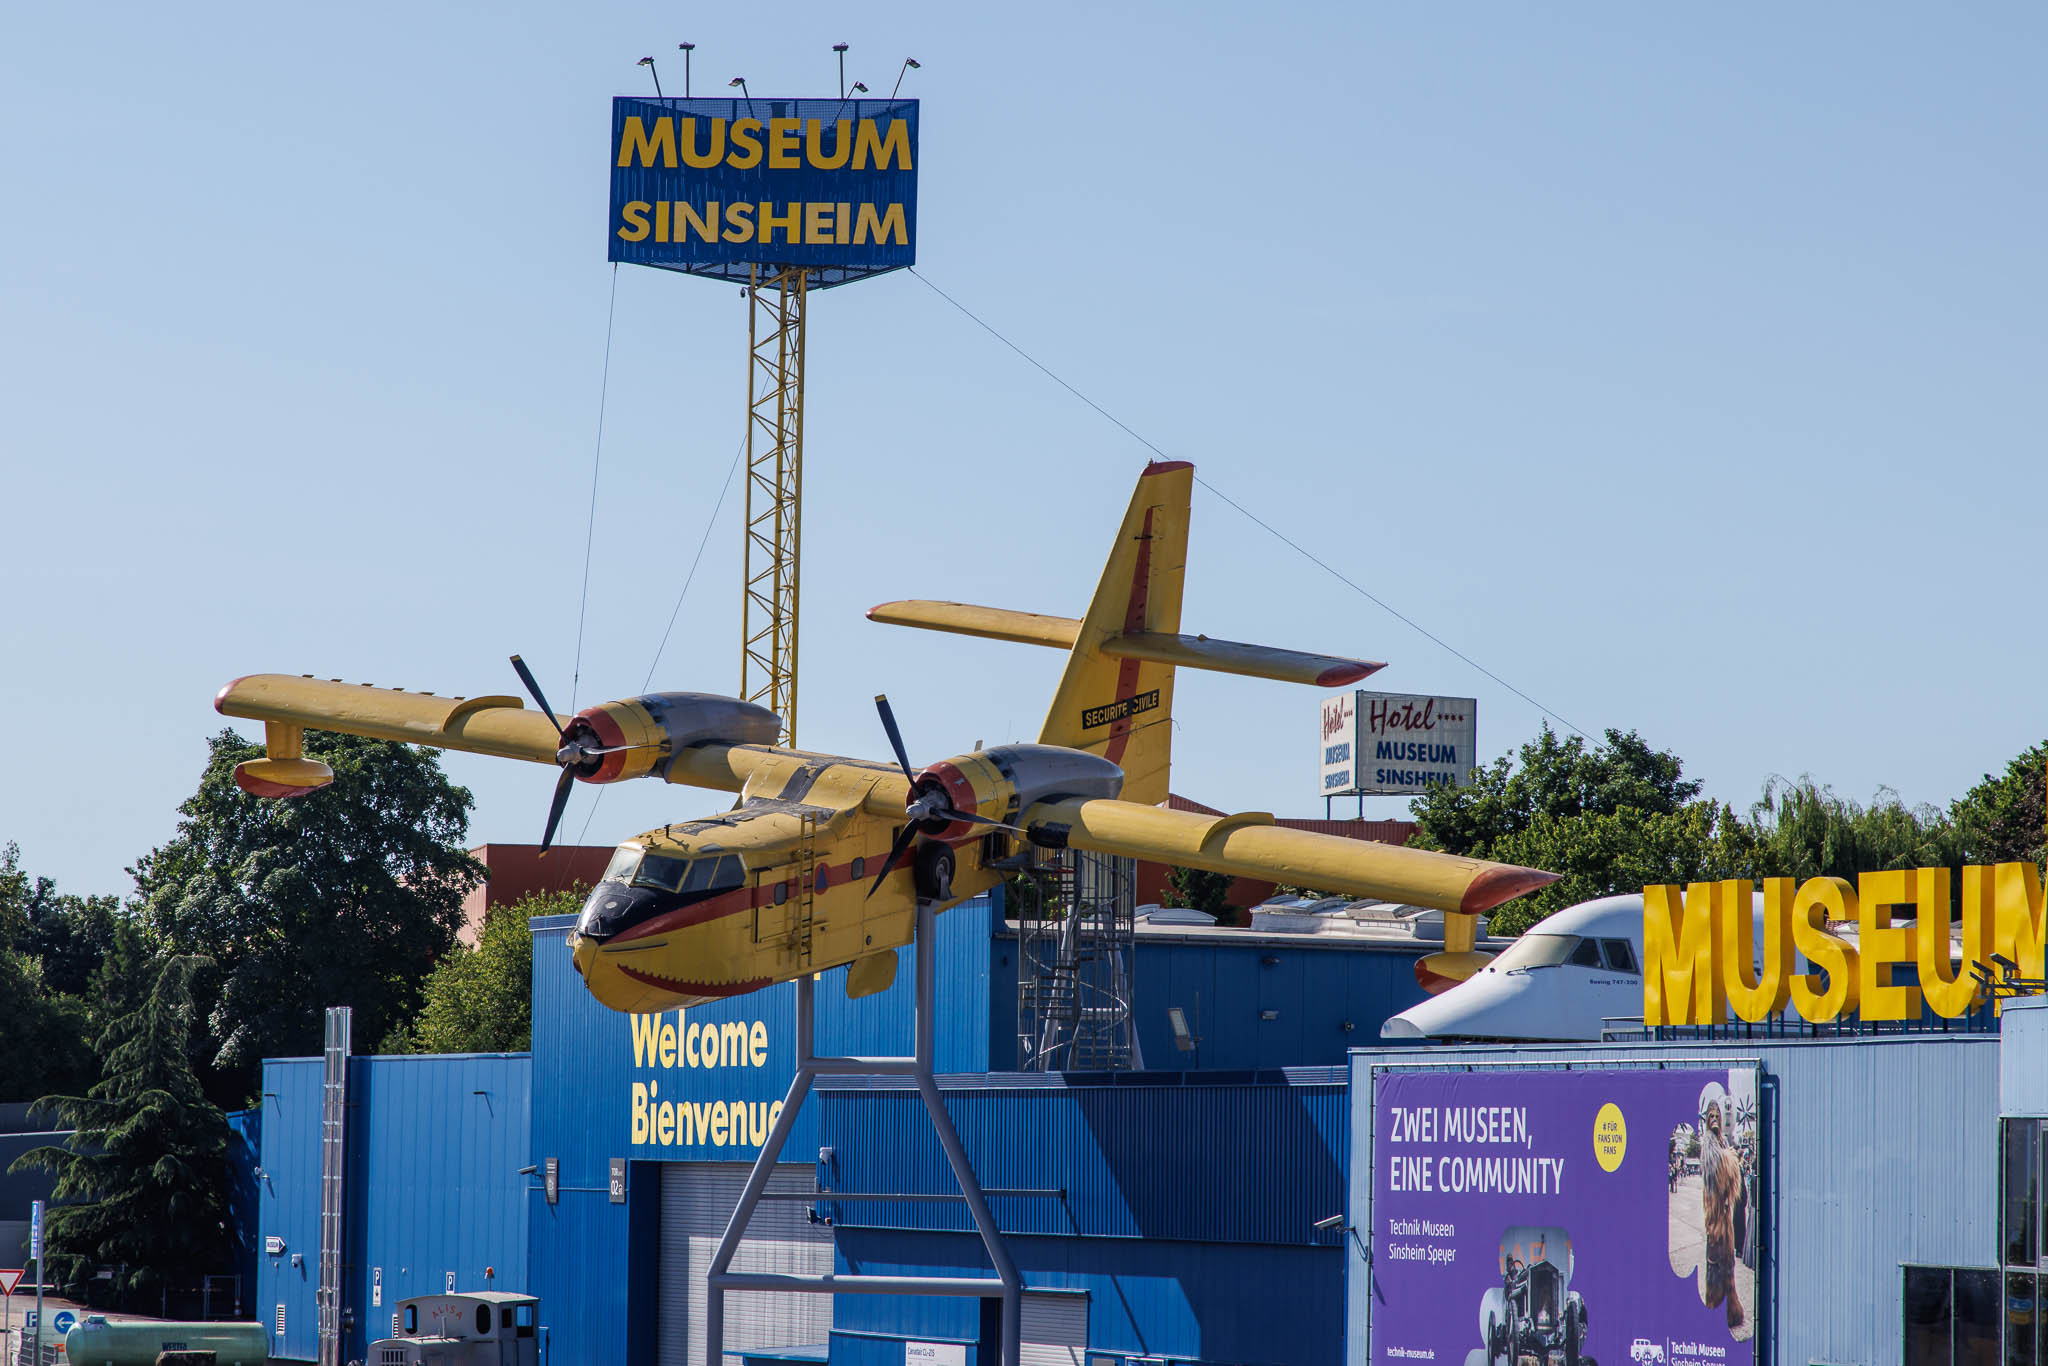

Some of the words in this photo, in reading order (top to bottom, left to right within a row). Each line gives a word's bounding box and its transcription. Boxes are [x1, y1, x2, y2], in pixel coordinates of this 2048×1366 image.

[617, 117, 913, 170] MUSEUM
[617, 200, 909, 245] SINSHEIM
[1085, 702, 1128, 726] SECURITE
[1132, 692, 1158, 713] CIVILE
[1323, 697, 1344, 741] Hotel
[1370, 698, 1436, 736] Hotel
[1325, 742, 1350, 766] MUSEUM
[1376, 741, 1456, 764] MUSEUM
[630, 1009, 768, 1069] Welcome
[1390, 1107, 1438, 1143] ZWEI
[1444, 1107, 1533, 1150] MUSEEN,
[1607, 1121, 1617, 1131] FÜR
[1597, 1134, 1611, 1144] FANS
[1611, 1134, 1623, 1144] VON
[1603, 1145, 1616, 1155] FANS
[1390, 1157, 1433, 1192] EINE
[1438, 1157, 1564, 1195] COMMUNITY
[1389, 1219, 1421, 1237] Technik
[1422, 1220, 1455, 1238] Museen
[1388, 1243, 1427, 1262] Sinsheim
[1427, 1245, 1457, 1265] Speyer
[432, 1303, 463, 1320] ALISA
[1387, 1346, 1435, 1360] technik-museum.de
[1671, 1341, 1698, 1355] Technik
[1698, 1343, 1726, 1357] Museen
